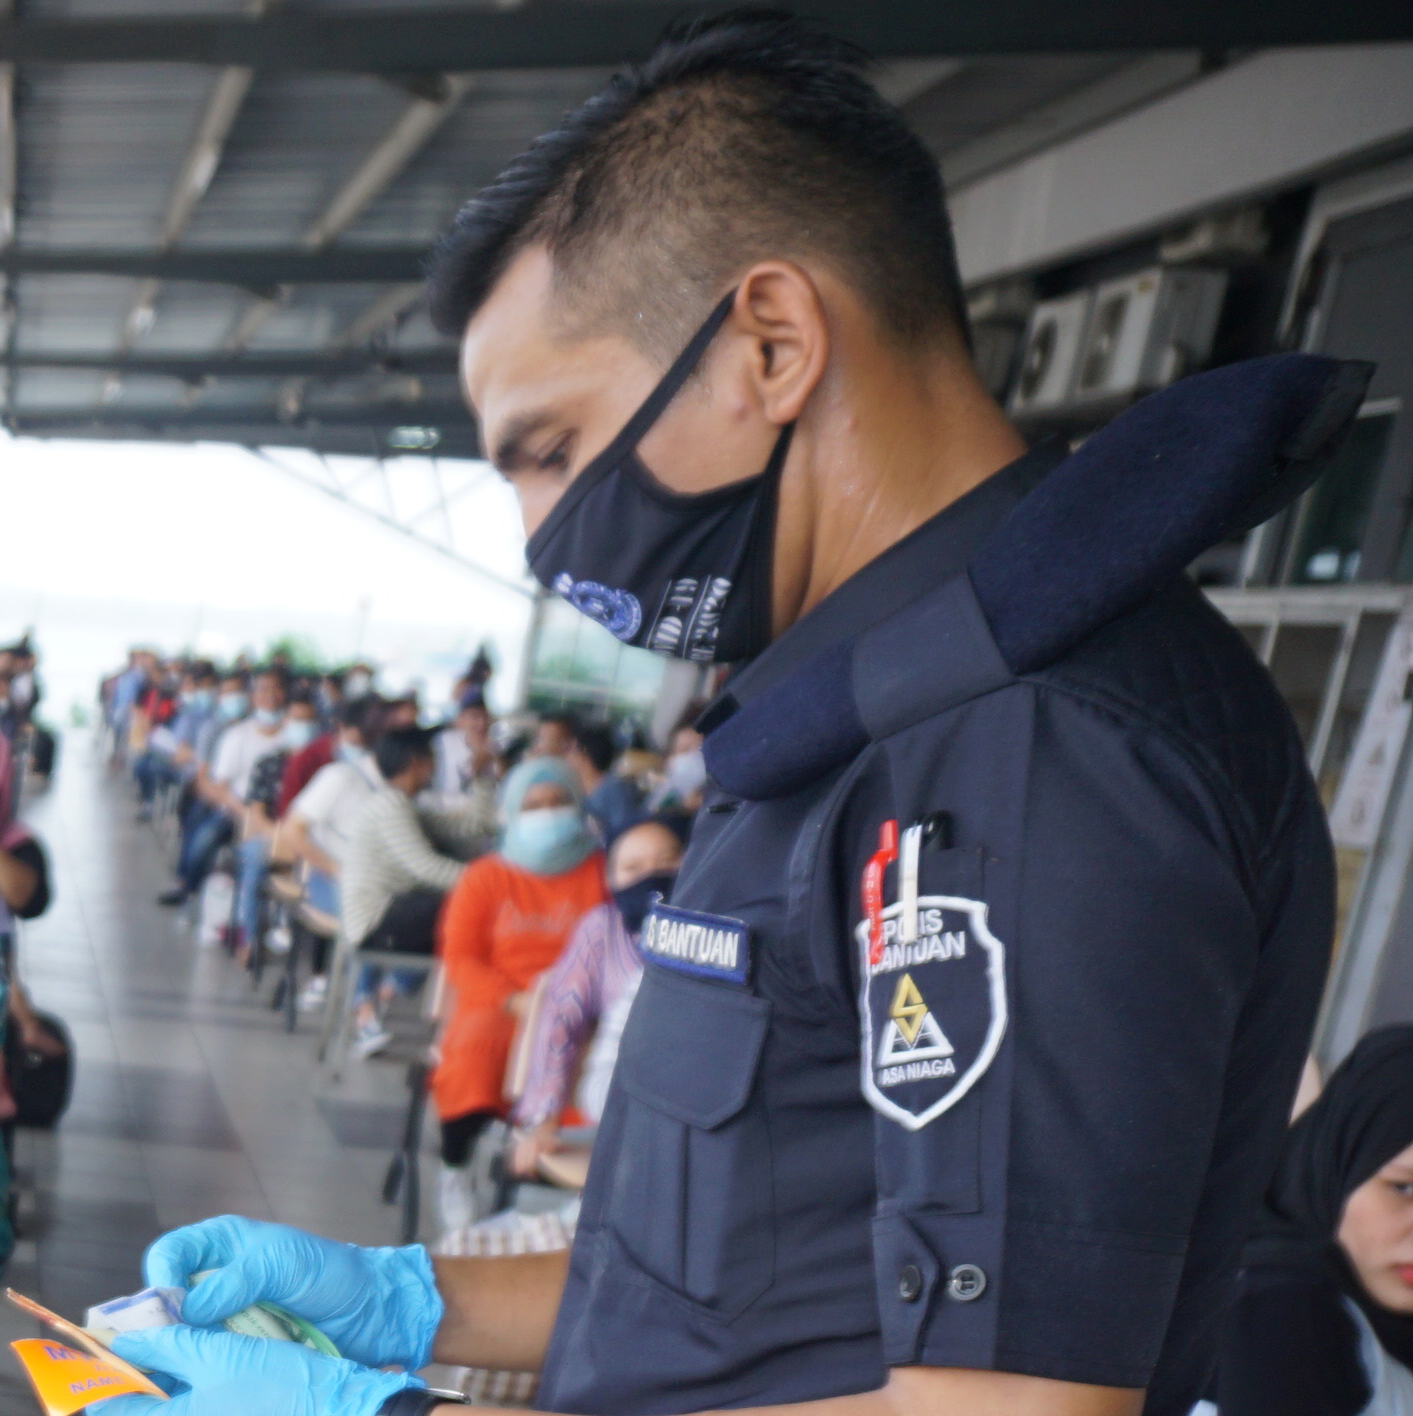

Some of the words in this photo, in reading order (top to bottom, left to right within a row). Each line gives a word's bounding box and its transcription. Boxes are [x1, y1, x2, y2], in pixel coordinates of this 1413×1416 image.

[658, 919, 739, 968] BANTUAN
[872, 931, 966, 976] ANTUAN
[906, 1057, 956, 1080] NIAGA
